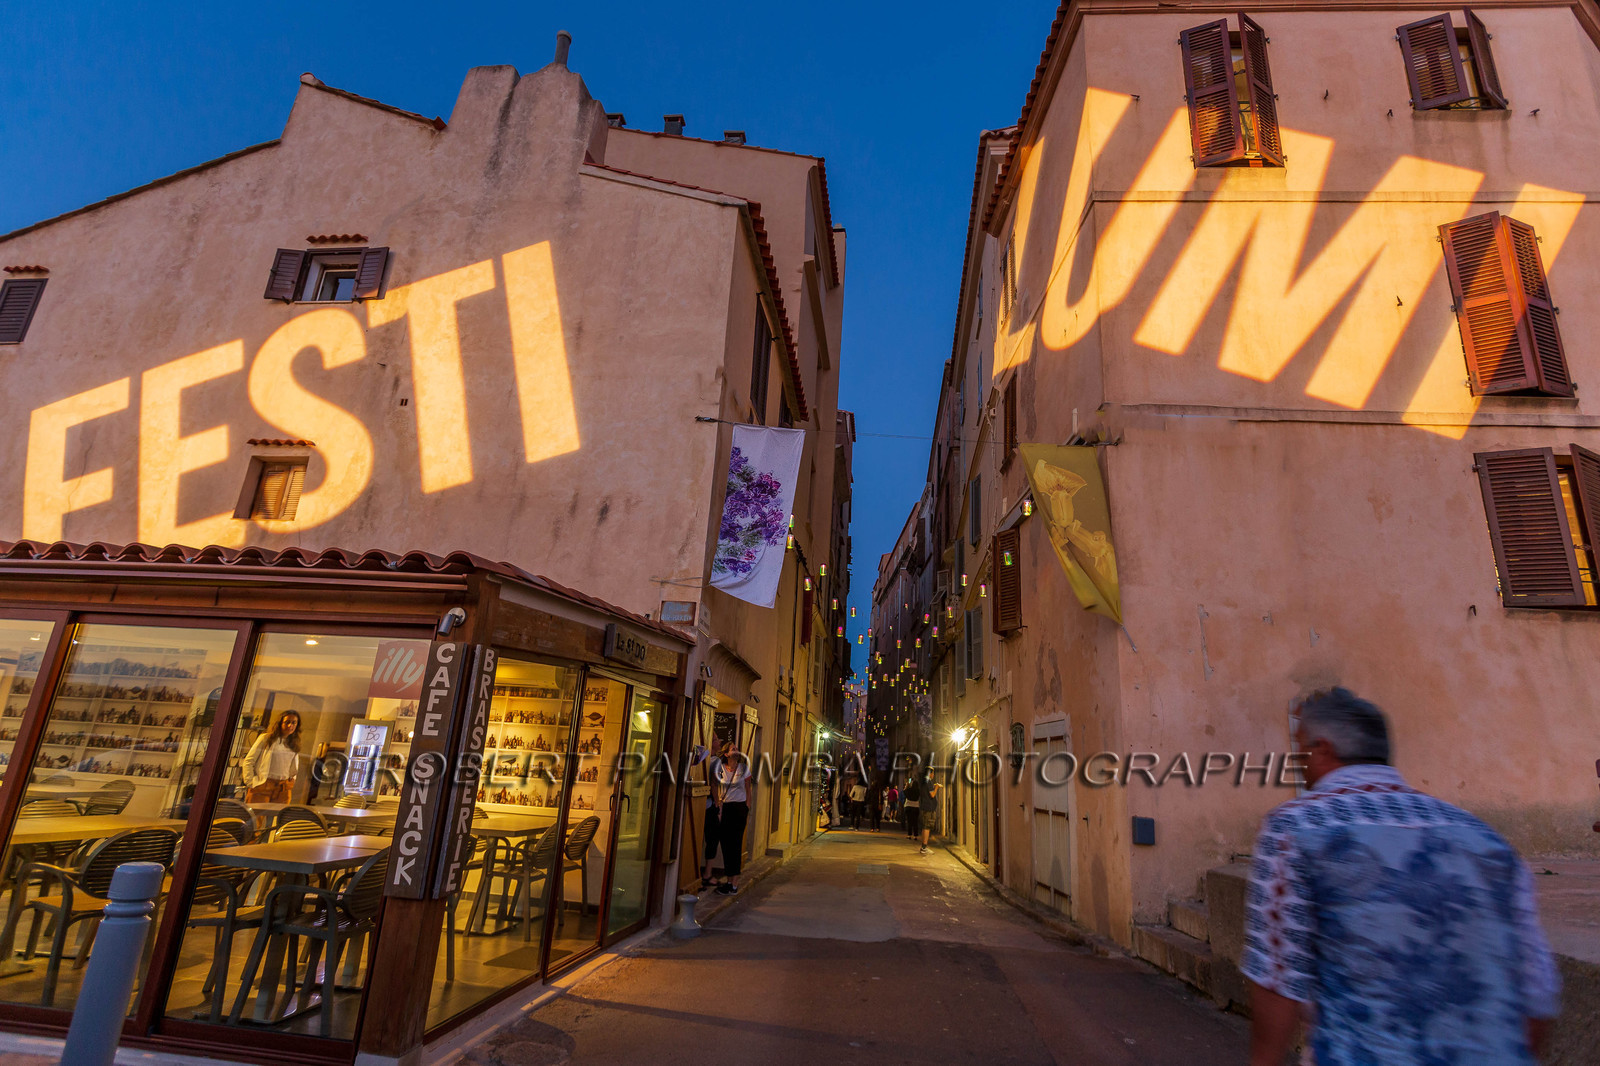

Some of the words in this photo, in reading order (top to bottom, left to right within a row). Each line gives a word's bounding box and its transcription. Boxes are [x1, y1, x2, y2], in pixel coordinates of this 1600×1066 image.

[991, 86, 1586, 441] LUMI
[22, 240, 581, 549] FESTI
[373, 647, 425, 693] illy
[421, 642, 456, 737] CAFE
[393, 752, 436, 886] SNACK
